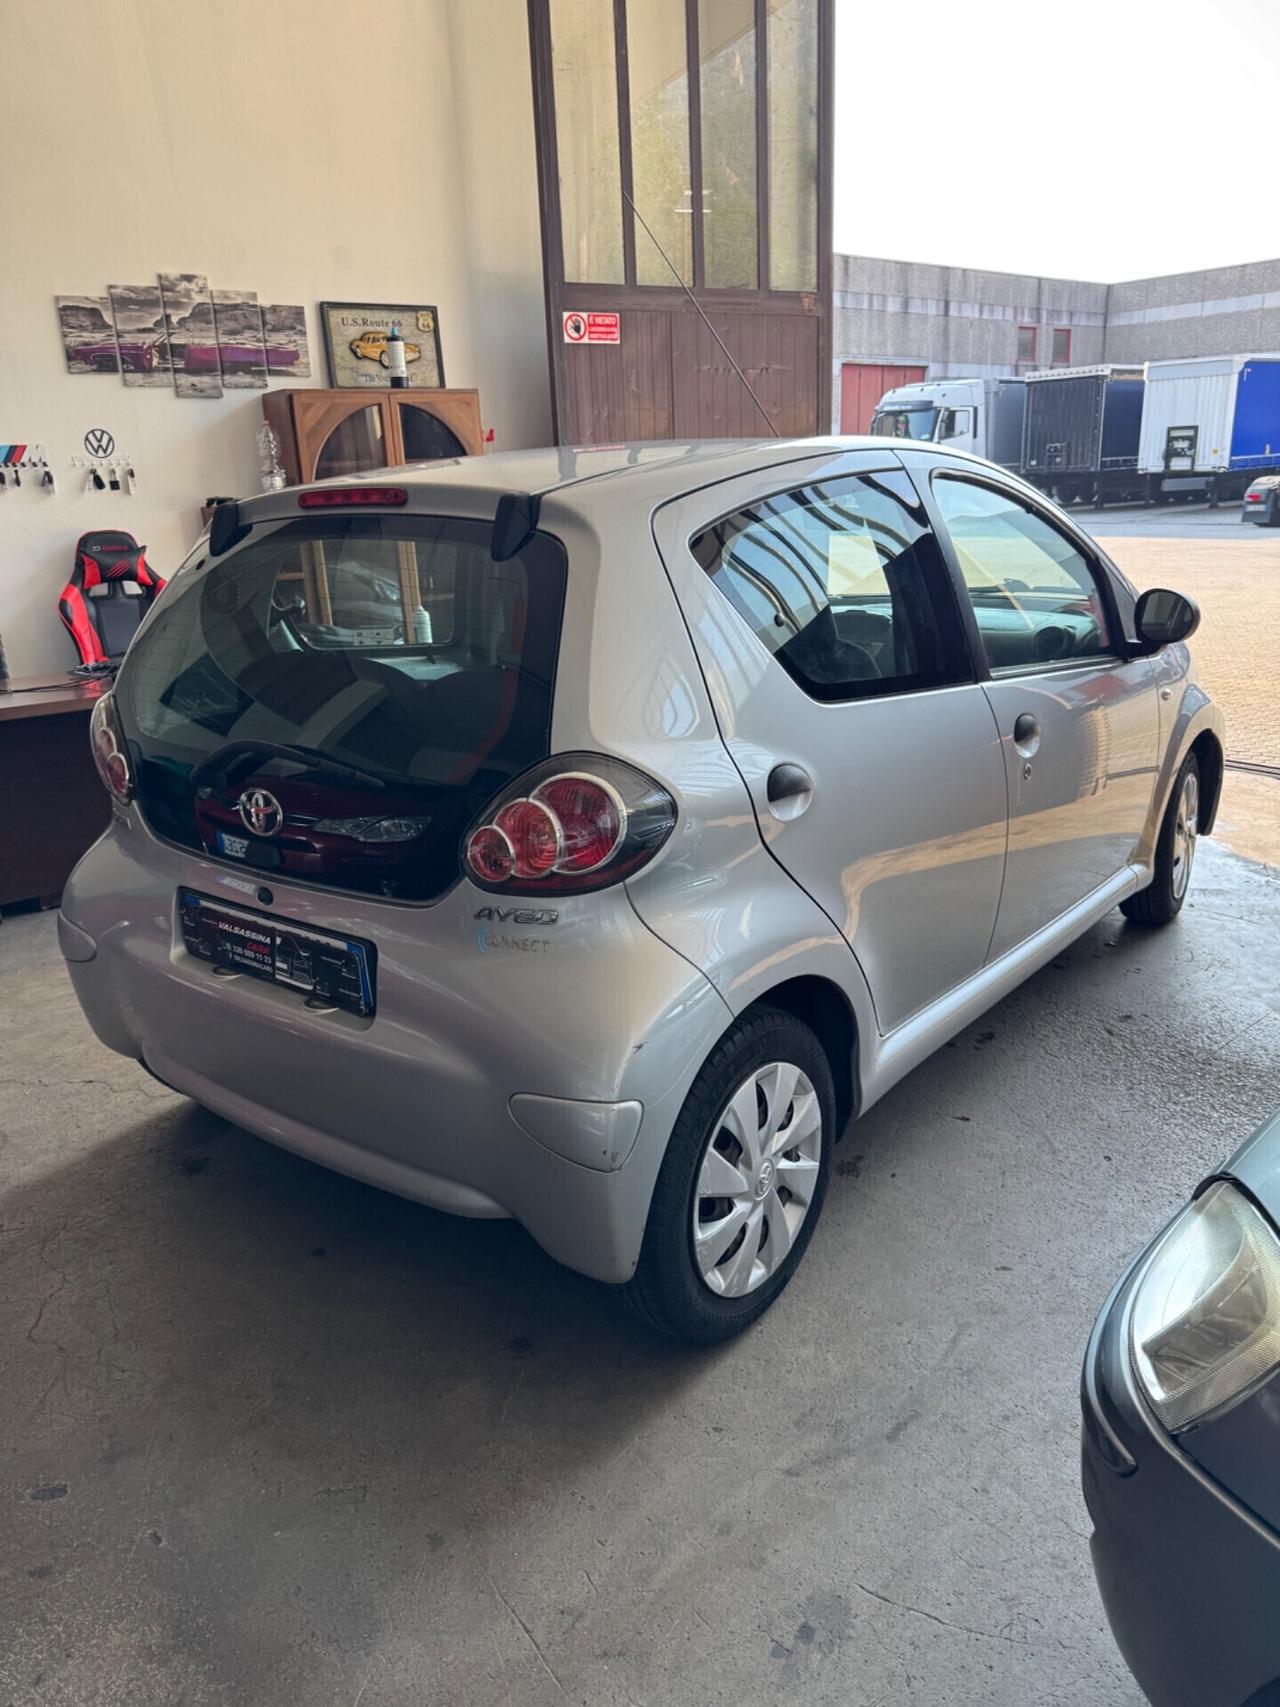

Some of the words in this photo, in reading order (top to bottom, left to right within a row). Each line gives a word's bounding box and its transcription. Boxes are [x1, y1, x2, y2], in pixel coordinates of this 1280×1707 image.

[341, 317, 389, 327] U.S.Route
[392, 319, 404, 328] 66
[474, 906, 559, 925] AYGO
[218, 921, 272, 945] VALSASSINA
